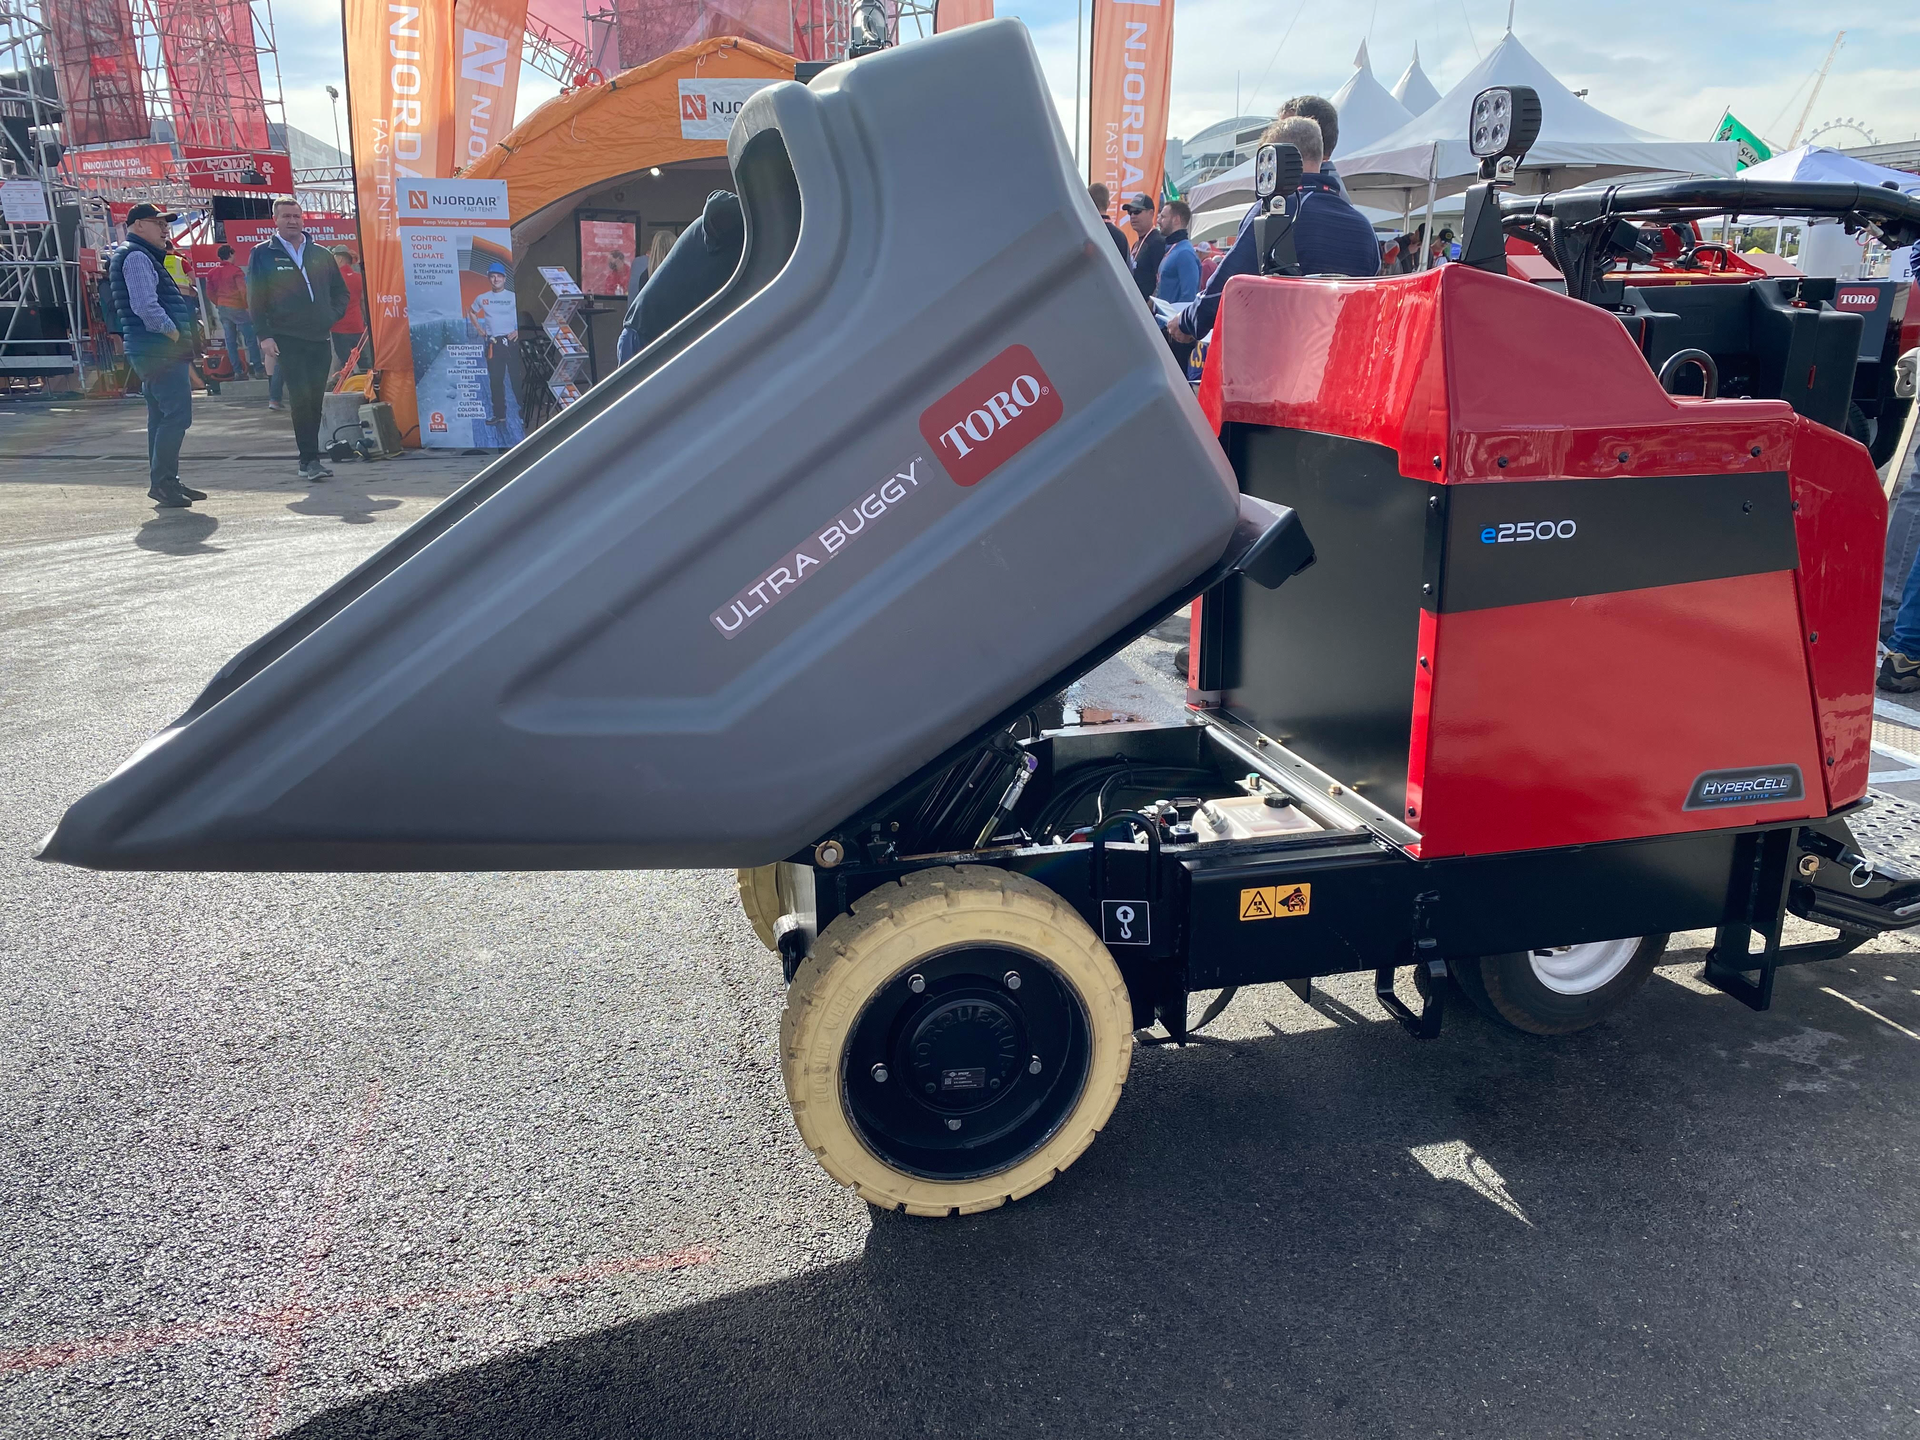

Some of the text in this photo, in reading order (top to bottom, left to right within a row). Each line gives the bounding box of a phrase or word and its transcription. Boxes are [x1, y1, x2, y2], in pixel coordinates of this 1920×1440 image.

[713, 101, 743, 114] NJO
[388, 4, 422, 236] NJORDA
[467, 94, 492, 166] NJO
[372, 118, 391, 167] FAST
[1105, 122, 1119, 164] FAST
[82, 158, 141, 170] INNOVATION FOR
[261, 161, 275, 174] &
[127, 167, 153, 176] TRADE
[213, 171, 272, 185] FIN
[196, 261, 222, 269] SLEDG
[377, 292, 402, 303] Keep
[1841, 294, 1874, 304] TORO
[384, 305, 399, 318] All
[434, 414, 441, 423] 5
[1481, 519, 1577, 544] e2500
[715, 552, 820, 631] ULTRA
